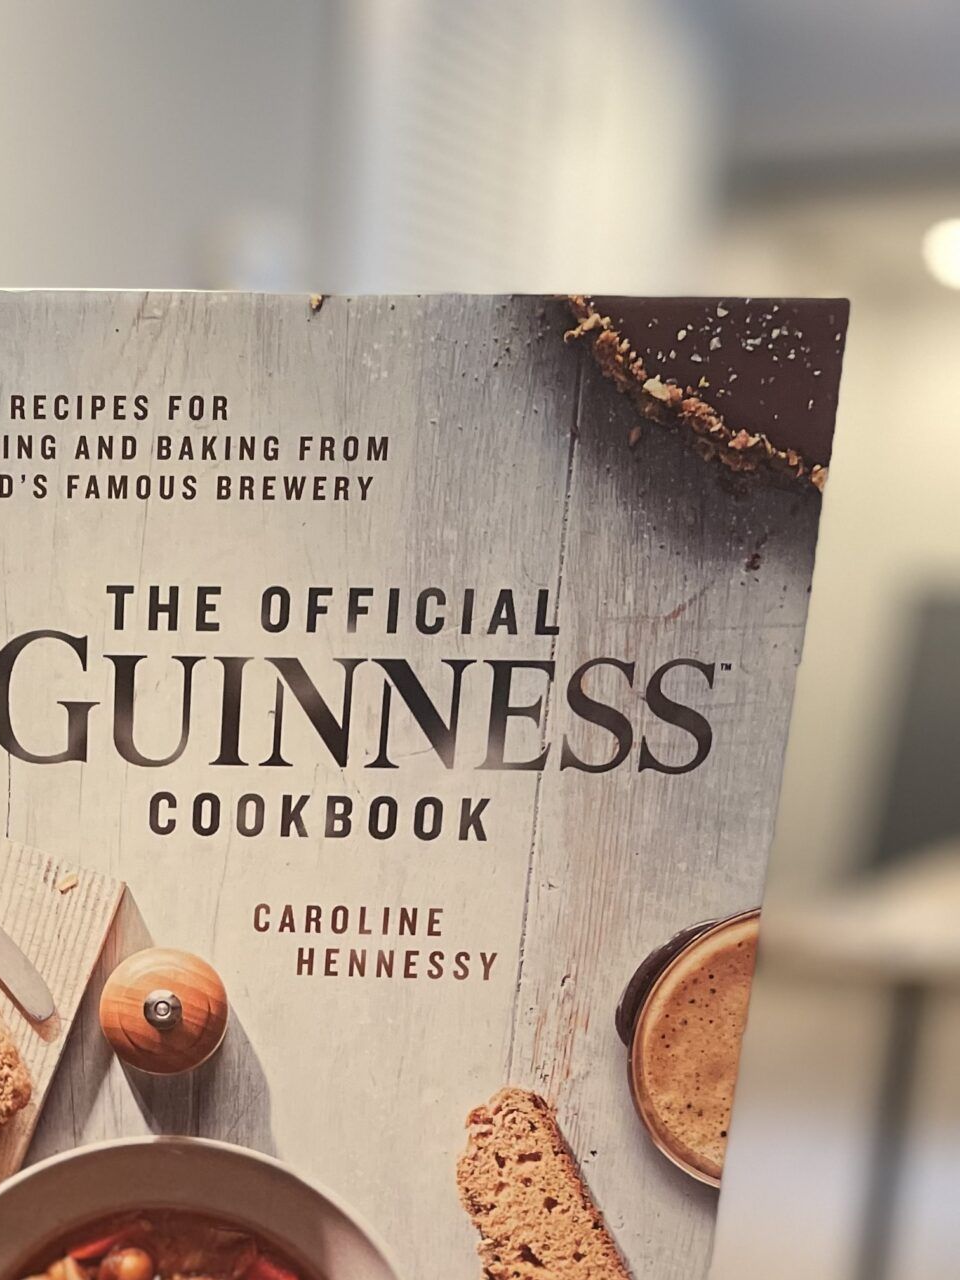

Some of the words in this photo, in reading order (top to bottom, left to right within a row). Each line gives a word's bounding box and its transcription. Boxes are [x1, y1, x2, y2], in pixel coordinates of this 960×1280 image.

[10, 394, 149, 421] RECIPES
[168, 395, 228, 421] FOR
[74, 435, 138, 460] AND
[156, 435, 280, 462] BAKING
[299, 435, 390, 462] FROM
[66, 474, 197, 501] FAMOUS
[216, 475, 375, 501] BREWERY
[106, 584, 222, 633] THE
[259, 585, 561, 637] OFFICIAL
[149, 791, 491, 843] COOKBOOK
[253, 903, 444, 937] CAROLINE
[296, 947, 498, 981] HENNESSY
